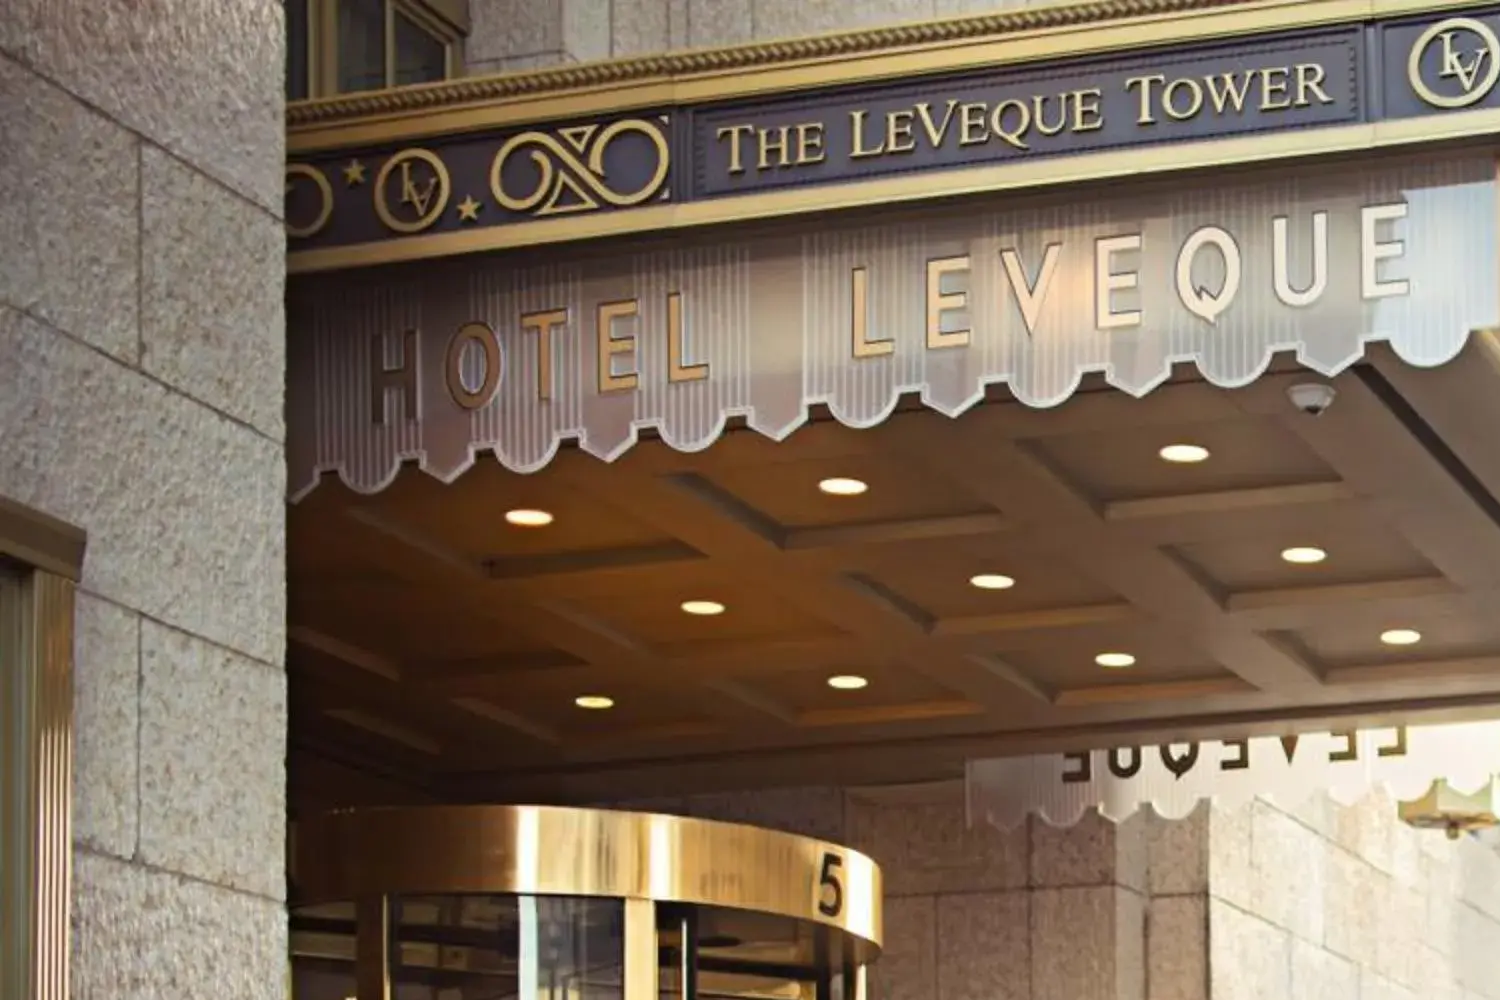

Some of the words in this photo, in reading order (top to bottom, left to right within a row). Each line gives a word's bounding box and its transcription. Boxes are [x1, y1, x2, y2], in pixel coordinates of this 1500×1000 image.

[717, 121, 826, 174] THE
[849, 88, 1104, 158] LEVEQUE
[1125, 62, 1334, 126] TOWER
[369, 291, 710, 425] HOTEL
[850, 201, 1411, 359] LEVEQUE
[818, 851, 843, 918] 5
